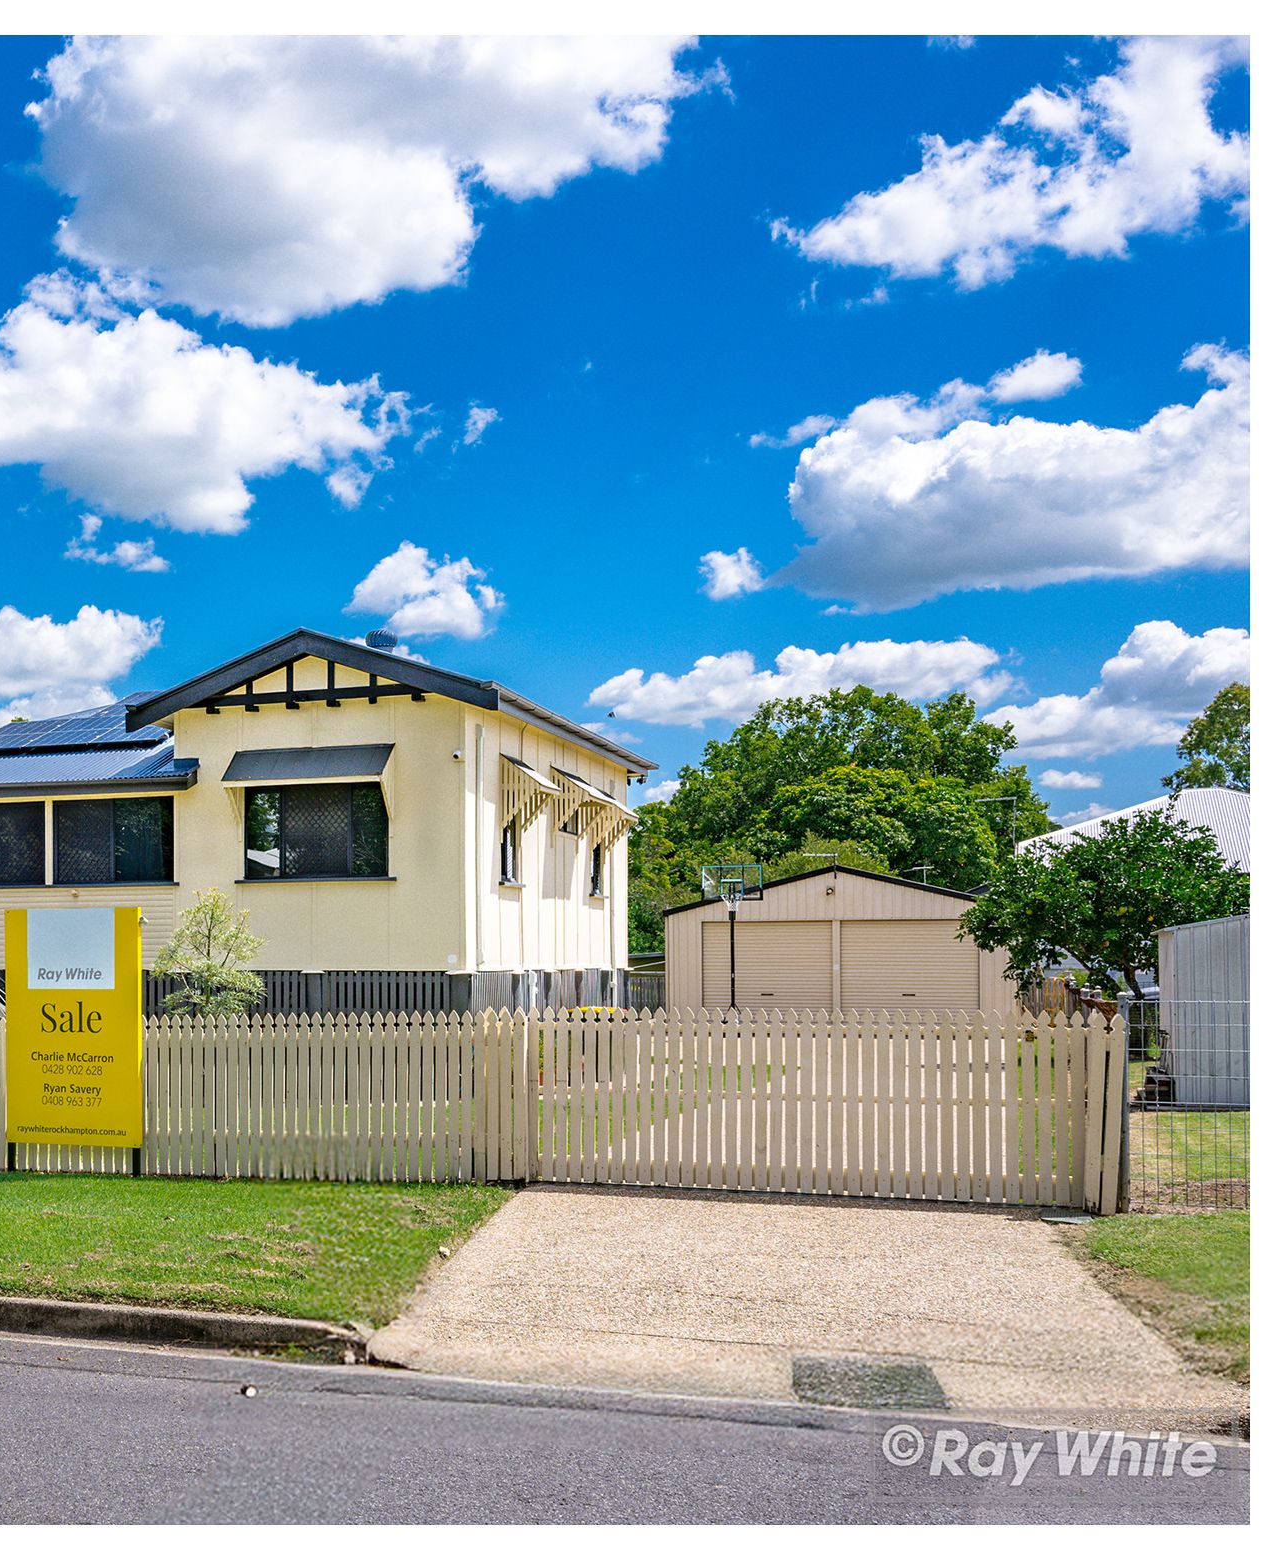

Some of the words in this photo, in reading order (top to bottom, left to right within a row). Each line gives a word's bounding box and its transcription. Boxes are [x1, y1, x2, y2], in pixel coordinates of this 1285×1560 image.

[37, 967, 63, 983] Ray
[65, 967, 103, 980] White
[40, 1000, 103, 1034] Sale
[30, 1051, 65, 1062] Charlie
[67, 1052, 114, 1063] McCarron
[41, 1064, 65, 1074] 0428
[66, 1065, 84, 1075] 902
[85, 1066, 103, 1076] 628
[43, 1083, 67, 1095] Ryan
[69, 1084, 102, 1097] Savery
[41, 1095, 65, 1106] 0408
[66, 1096, 84, 1107] 963
[85, 1097, 103, 1108] 377
[17, 1124, 127, 1137] raywhiterockhampton.com.au
